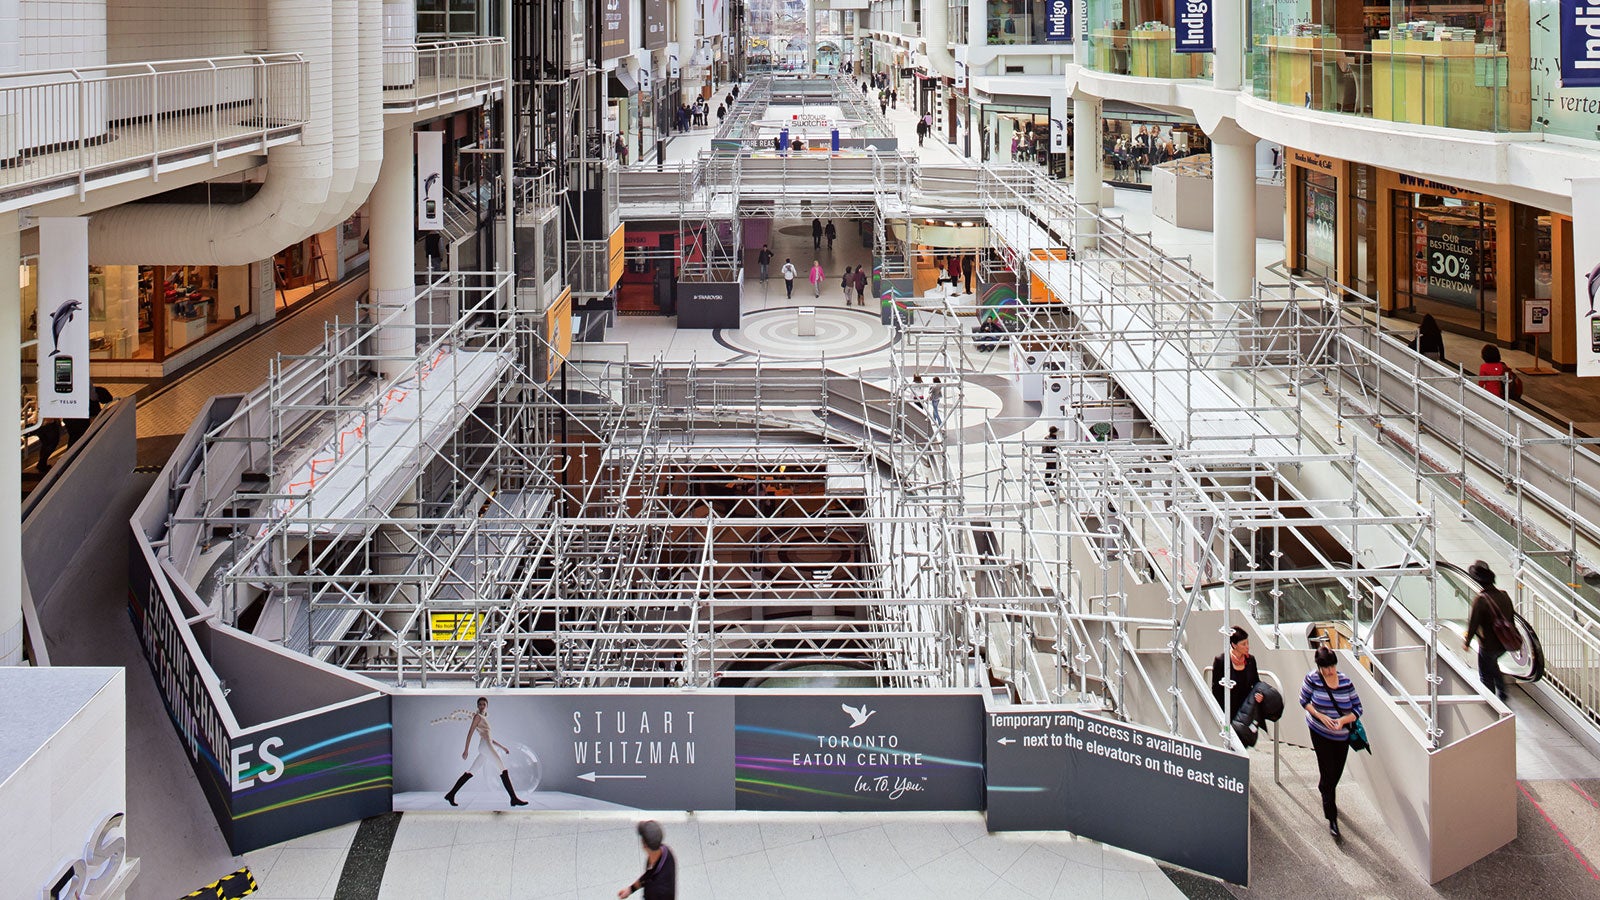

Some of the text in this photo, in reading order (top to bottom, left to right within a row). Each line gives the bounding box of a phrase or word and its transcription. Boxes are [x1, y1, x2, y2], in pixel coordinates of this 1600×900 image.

[1181, 0, 1208, 45] Indig
[1575, 0, 1600, 69] Indi
[1560, 95, 1600, 115] verte
[741, 140, 775, 148] MORE REAS
[1429, 239, 1474, 256] BESTSELLERS
[1442, 233, 1460, 244] OUR
[1429, 275, 1474, 295] EVERYDAY
[1459, 270, 1472, 281] off
[149, 578, 190, 698] EXCITING
[142, 608, 199, 764] ARE COMING
[573, 710, 696, 735] STUART
[817, 735, 899, 748] TORONTO
[990, 713, 1202, 761] Temporary ramp access is available
[574, 740, 696, 765] WEITZMAN
[792, 752, 923, 766] EATON CENTRE
[1023, 732, 1245, 795] next to the elevators on the east side
